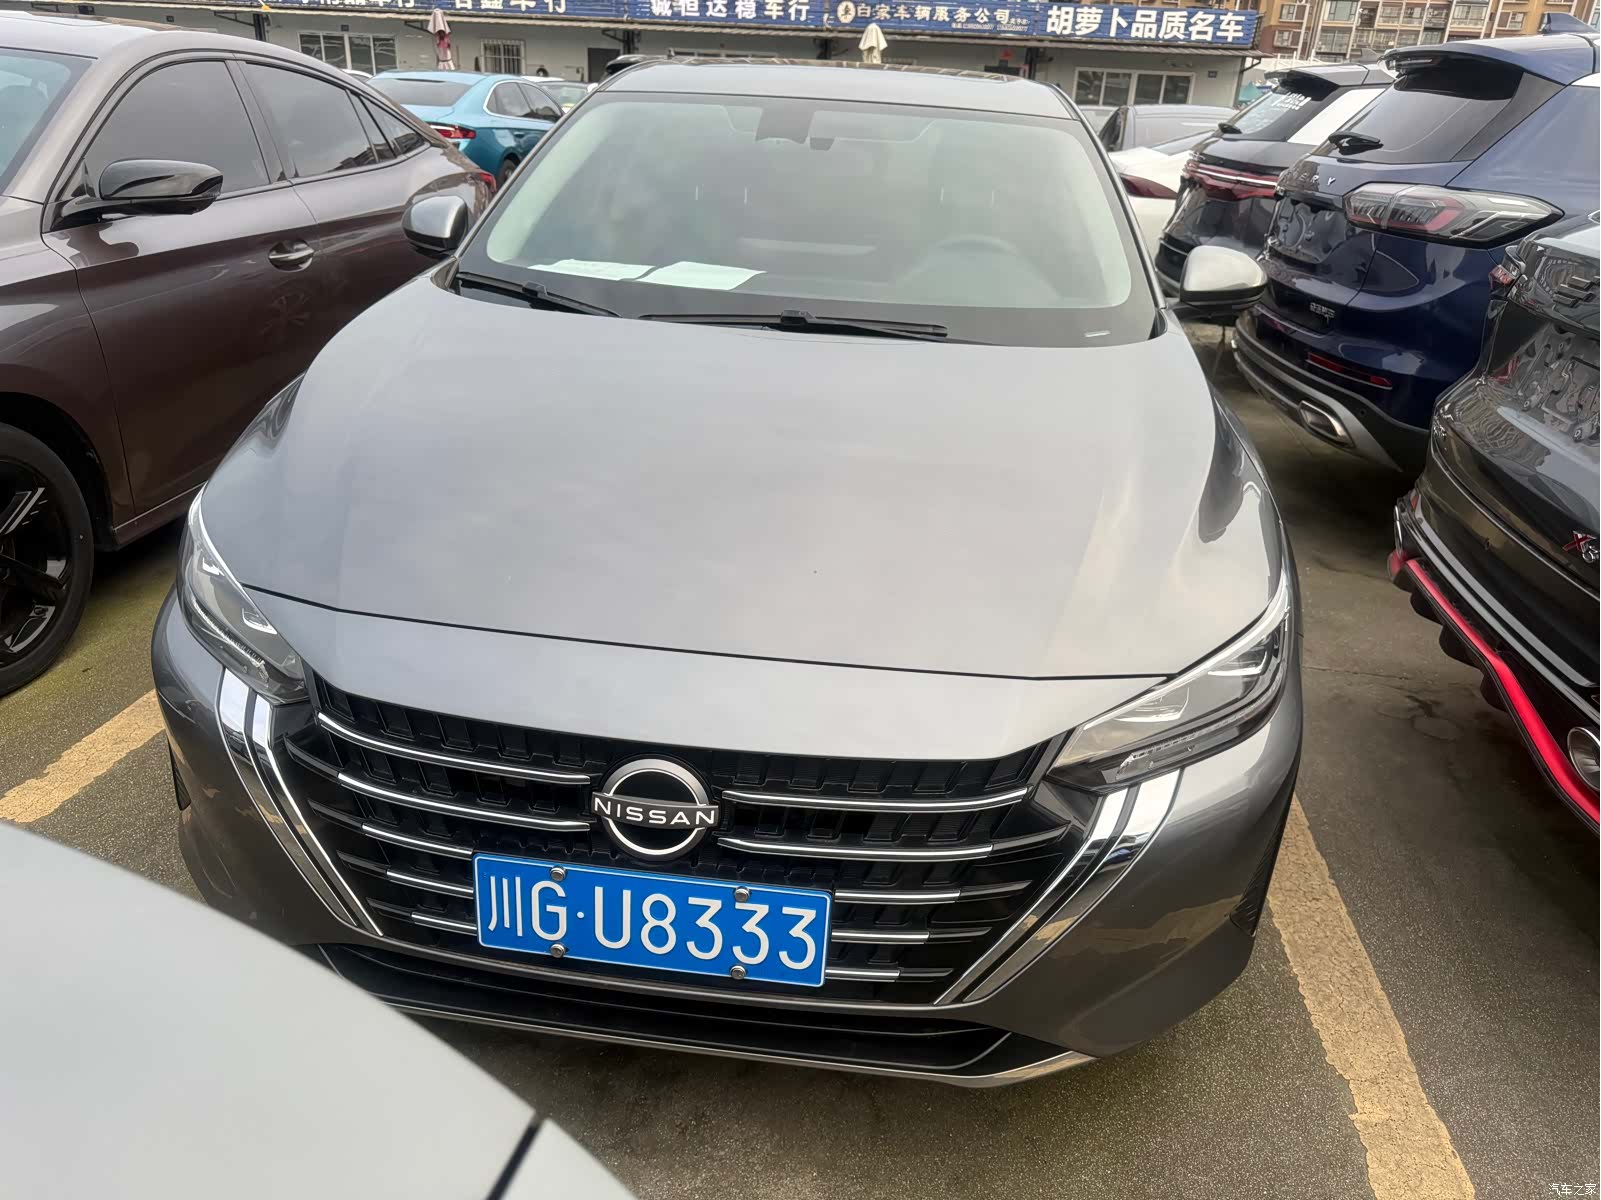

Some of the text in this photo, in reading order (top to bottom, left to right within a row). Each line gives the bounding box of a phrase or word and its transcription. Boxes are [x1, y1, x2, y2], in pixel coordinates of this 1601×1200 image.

[1046, 5, 1245, 42] 胡萝卜品质名车
[594, 797, 715, 826] NISSAN
